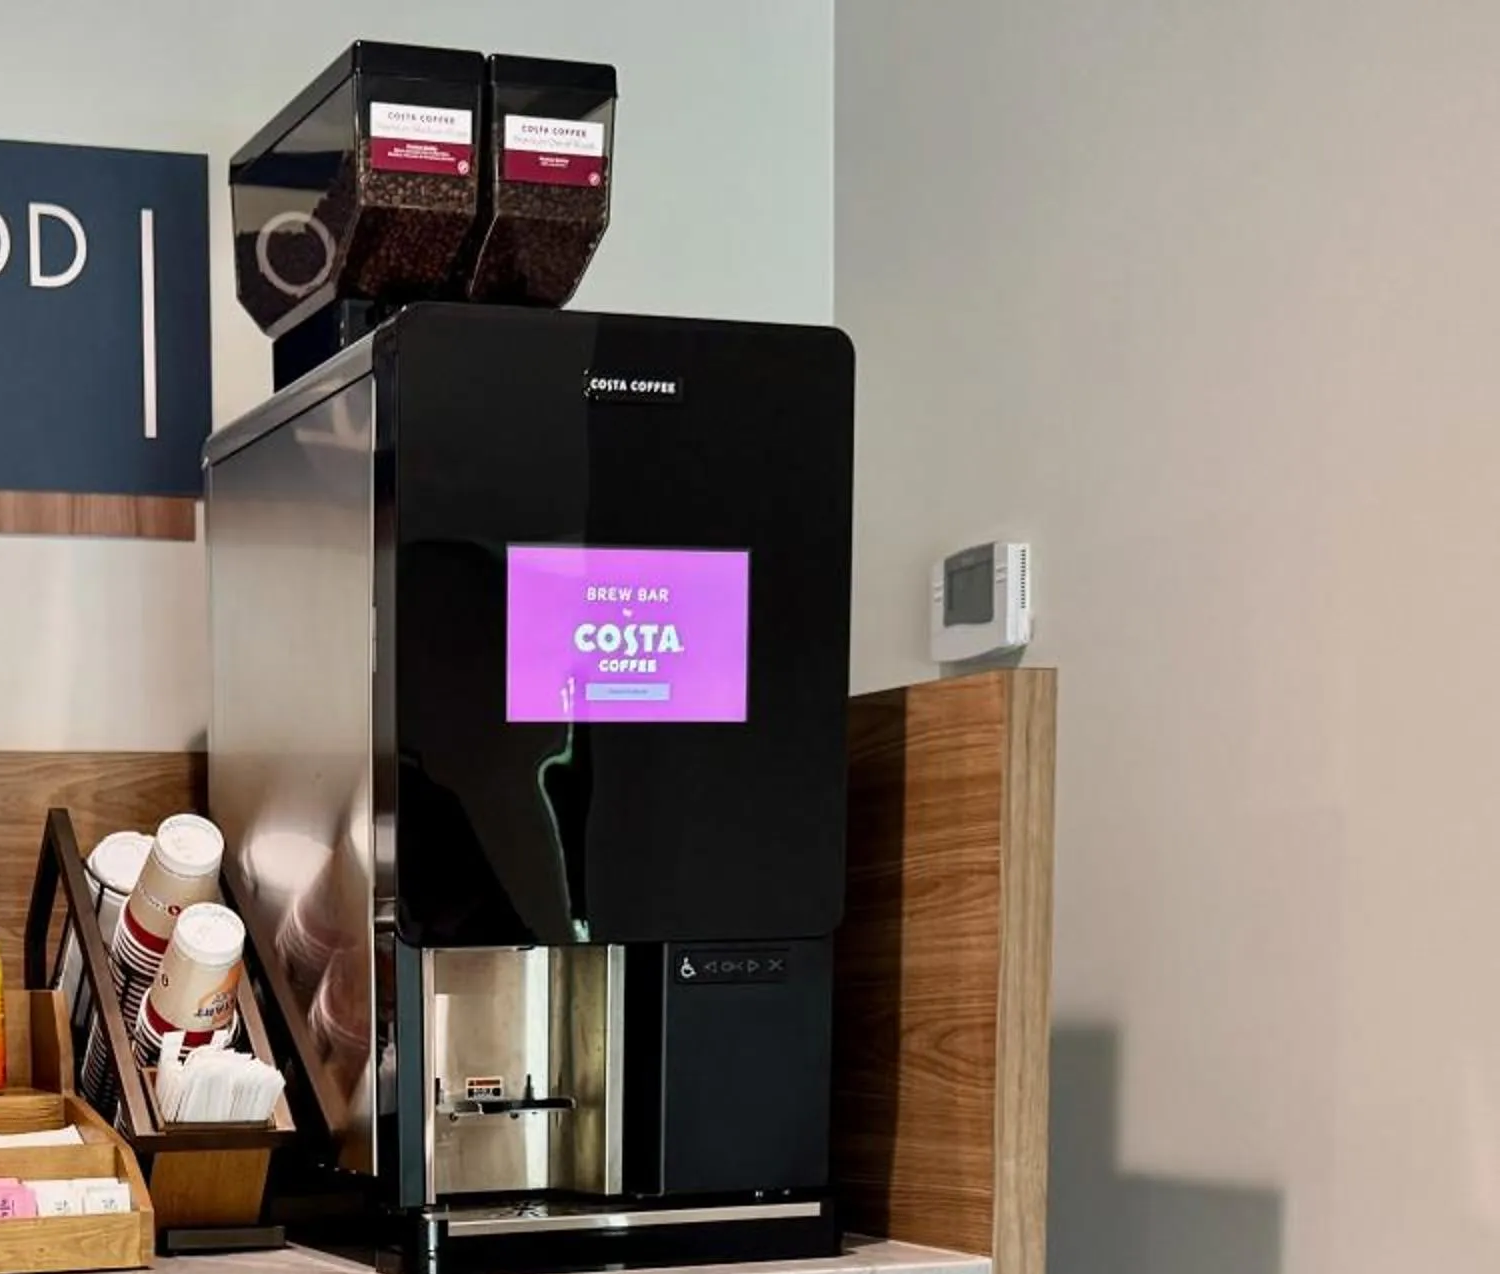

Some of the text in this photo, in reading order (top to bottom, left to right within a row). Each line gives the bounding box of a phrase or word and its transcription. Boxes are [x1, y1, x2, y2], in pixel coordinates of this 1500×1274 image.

[552, 127, 587, 138] COFFEE
[590, 377, 676, 394] COSTA COFFEE
[586, 586, 669, 602] BREW BAR
[574, 623, 684, 656] COSTA
[598, 659, 657, 673] COFFEE
